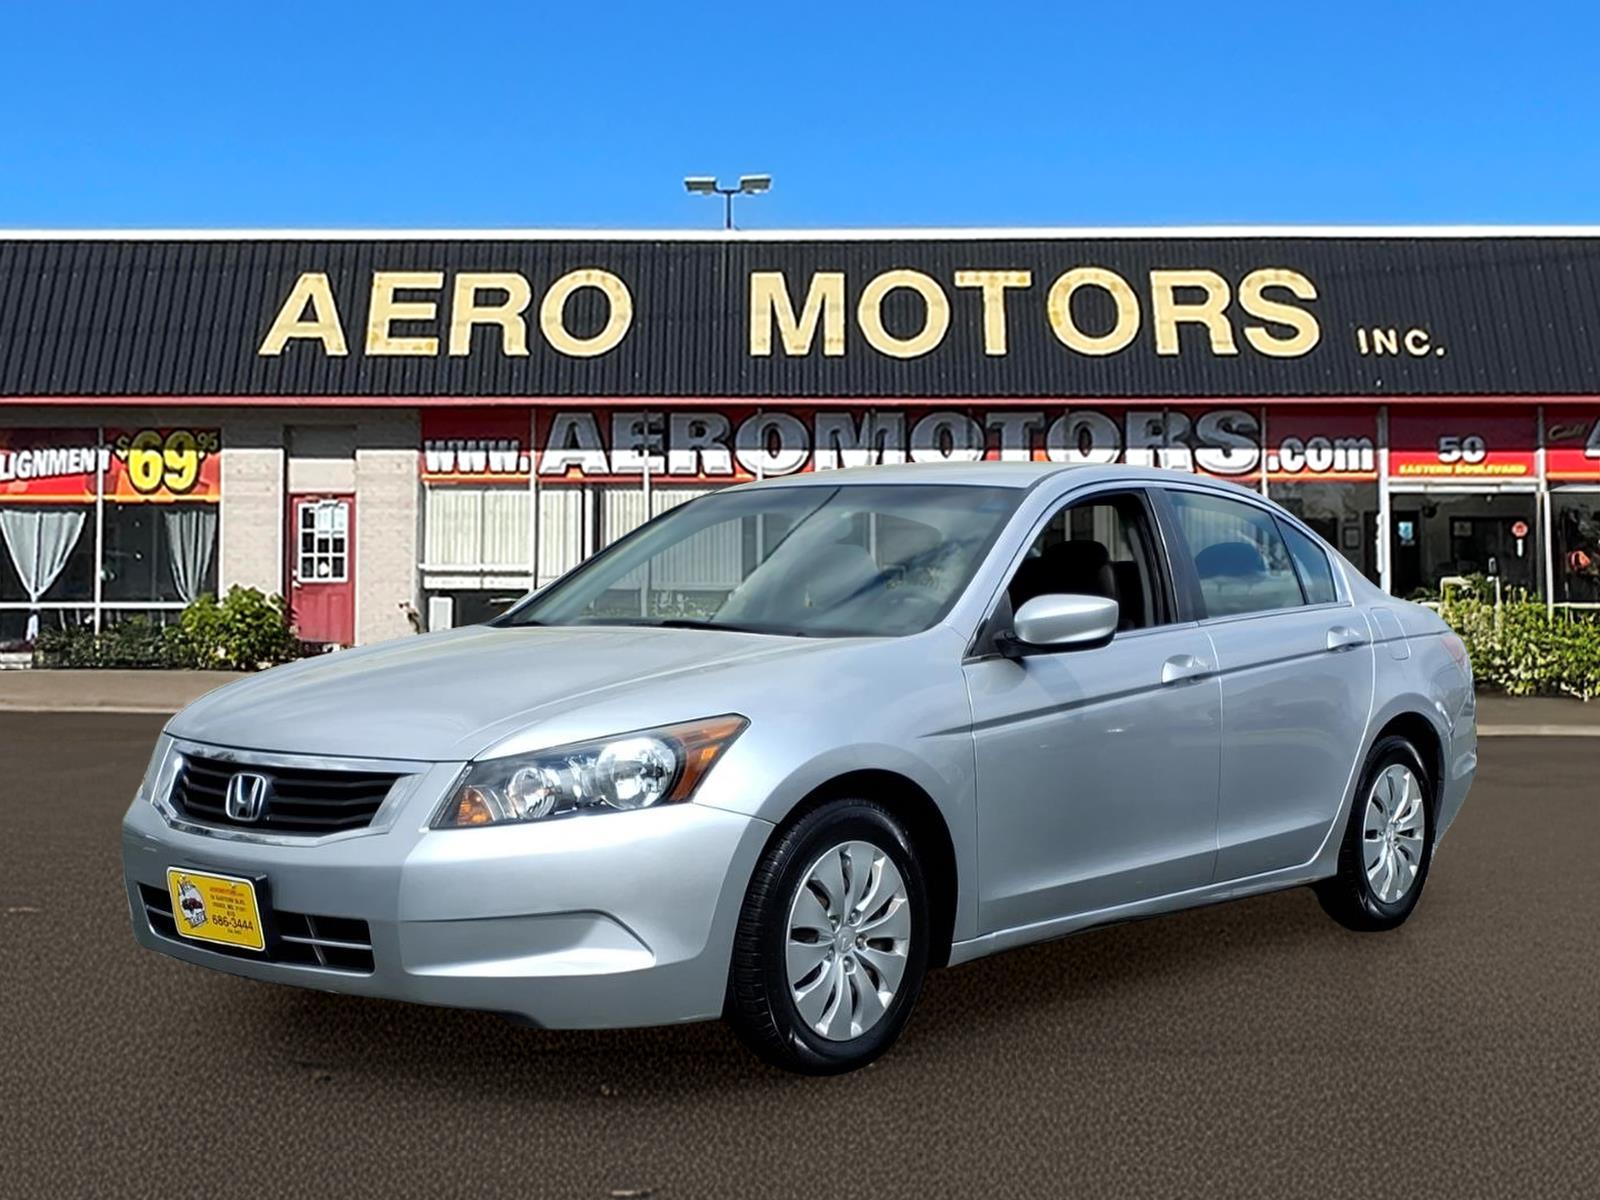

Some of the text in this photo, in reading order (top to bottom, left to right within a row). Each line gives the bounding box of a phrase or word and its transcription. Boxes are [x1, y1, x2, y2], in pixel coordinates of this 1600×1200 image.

[258, 267, 1444, 358] AERO MOTORS INC.
[1437, 436, 1486, 463] 50
